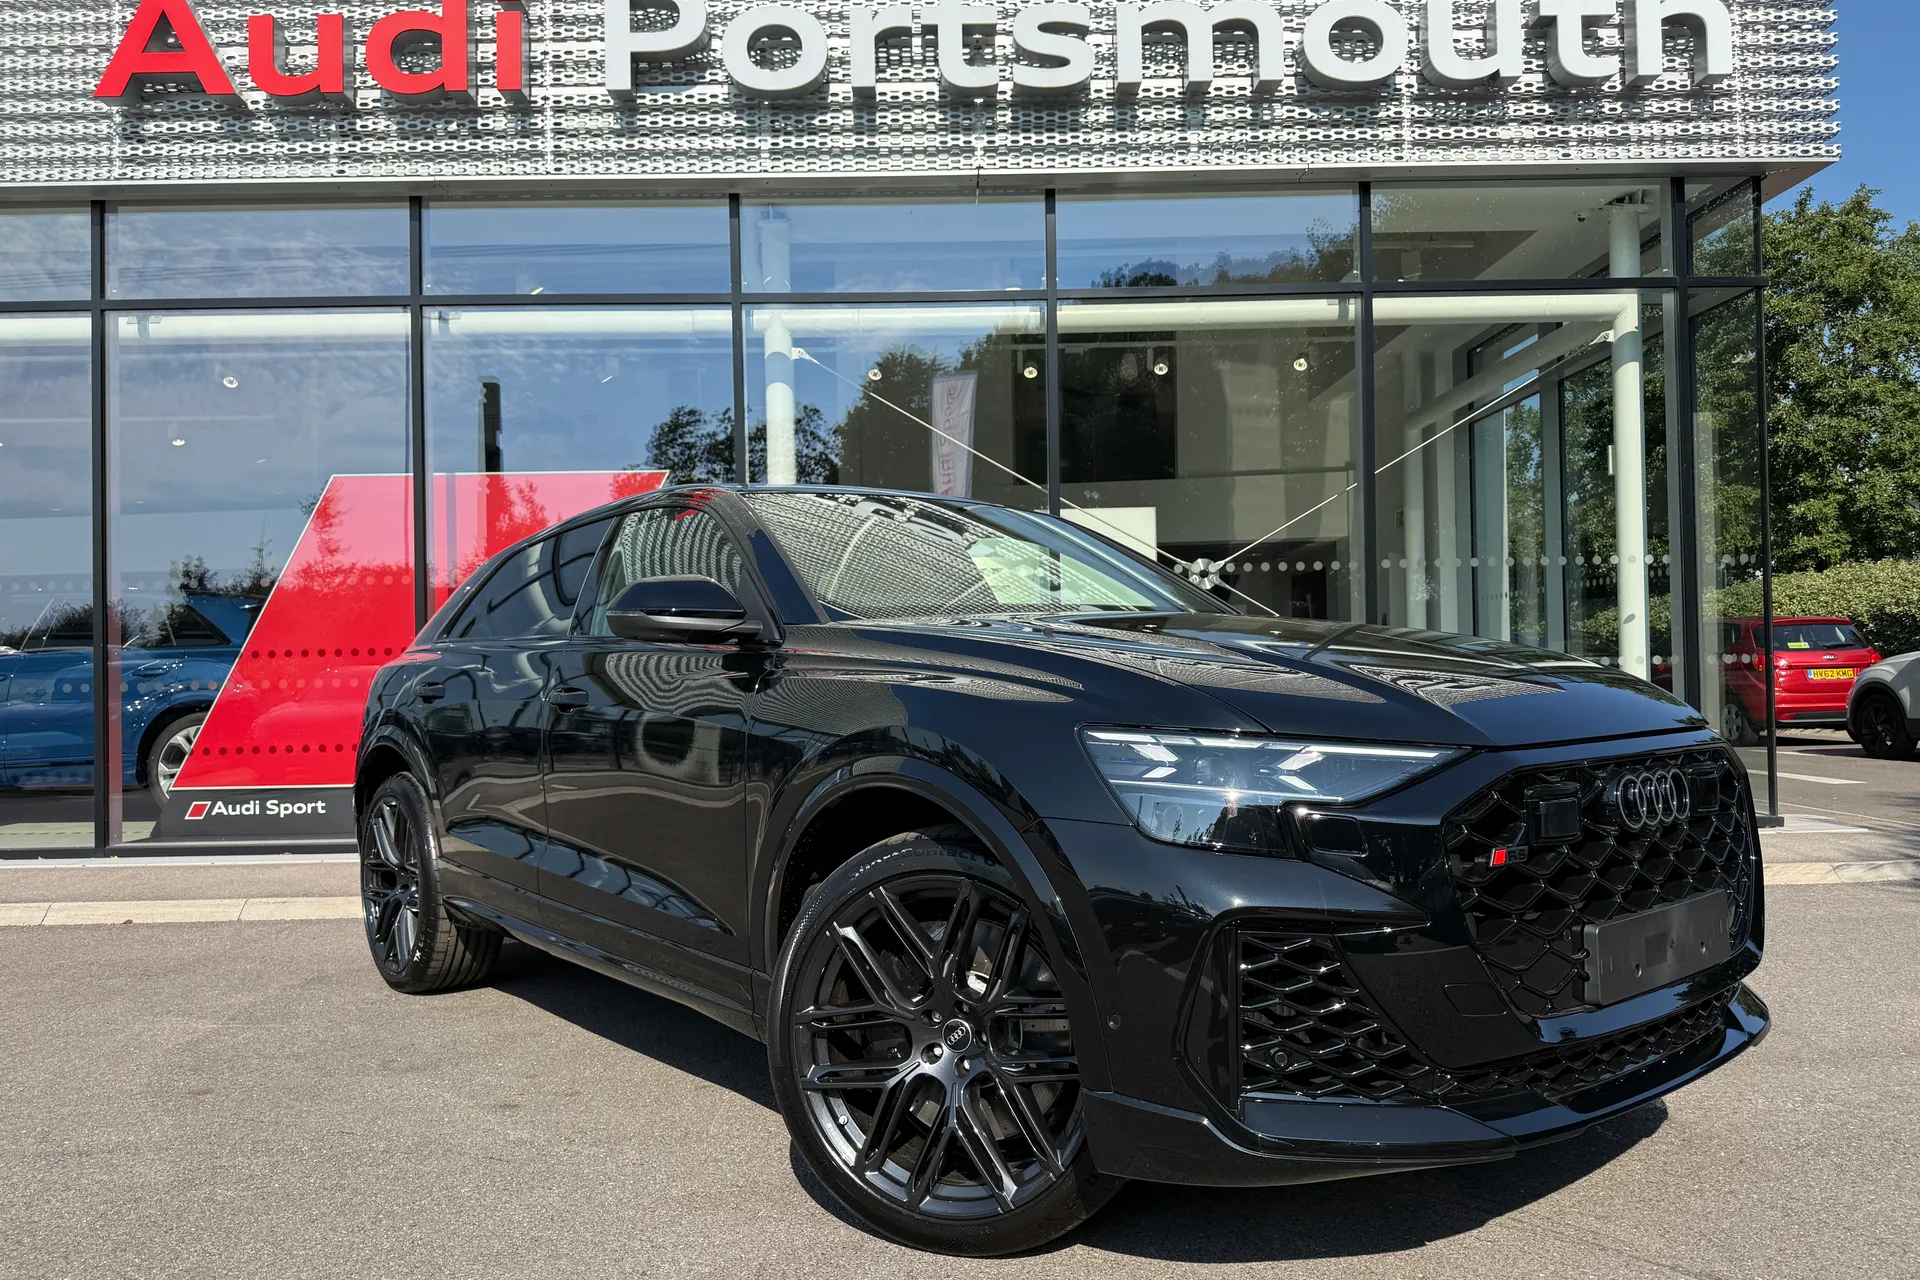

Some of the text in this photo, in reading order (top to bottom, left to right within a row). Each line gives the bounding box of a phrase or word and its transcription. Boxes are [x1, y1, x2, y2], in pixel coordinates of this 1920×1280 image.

[94, 0, 1733, 98] Audi Portsmouth
[1812, 669, 1853, 678] HV62 KMG
[211, 799, 326, 818] Audi Sport
[1507, 847, 1527, 862] RS
